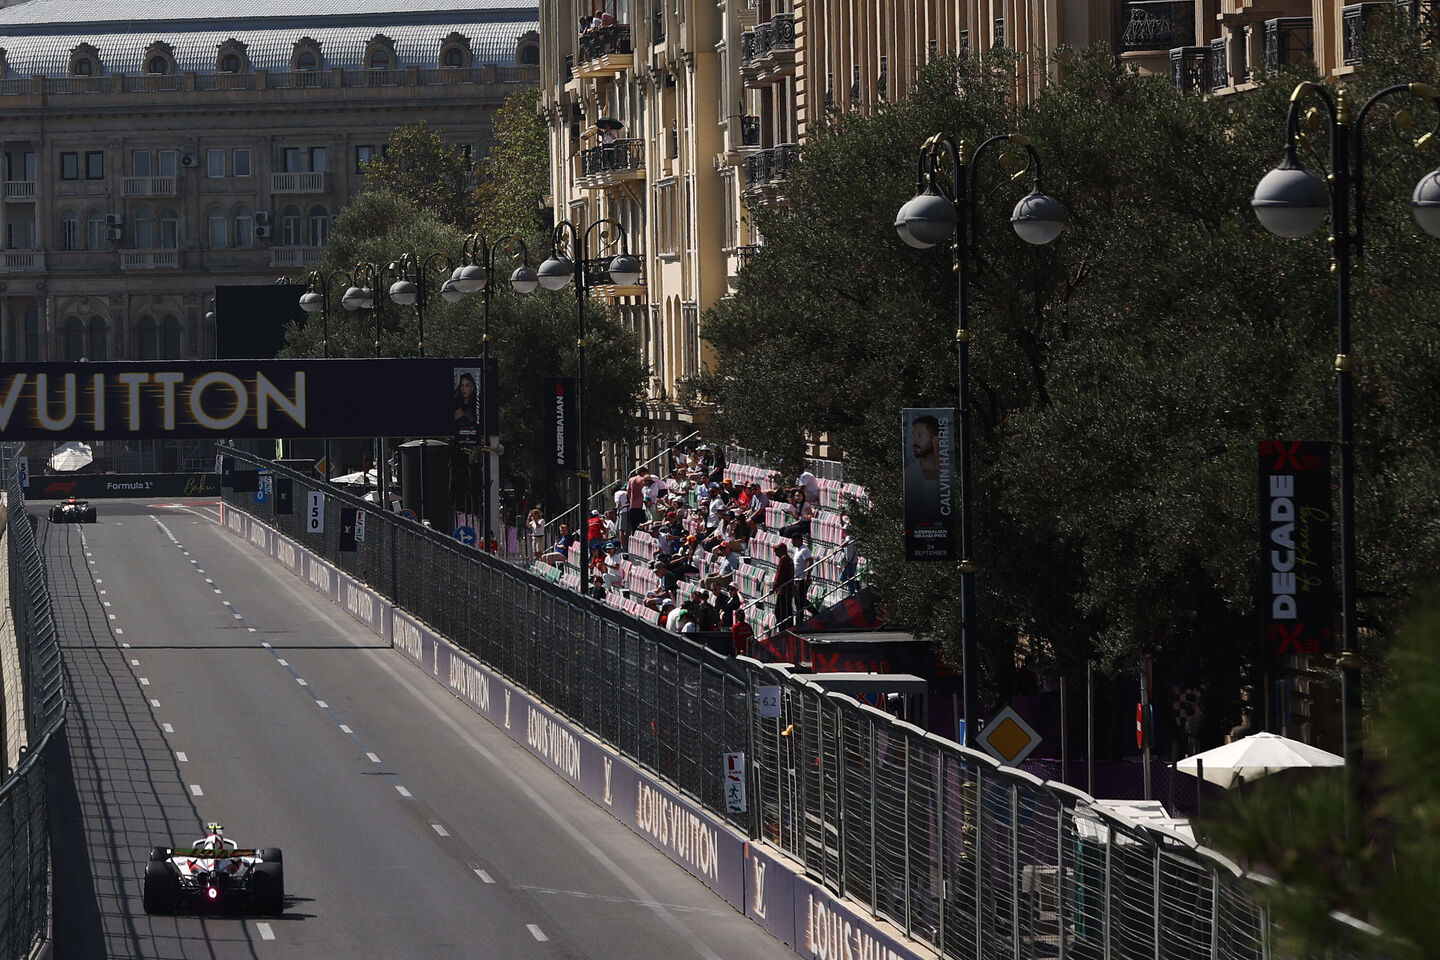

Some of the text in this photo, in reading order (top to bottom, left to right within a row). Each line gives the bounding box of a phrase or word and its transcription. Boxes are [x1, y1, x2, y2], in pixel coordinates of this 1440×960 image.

[107, 482, 143, 490] Formula
[938, 416, 952, 516] CALVIN HARRIS
[1269, 475, 1298, 620] DECADE
[763, 697, 777, 707] 6.2
[528, 705, 581, 783] LOUIS VUITTON
[638, 780, 719, 883] LOUIS VUITTON
[808, 894, 853, 960] LOUIS
